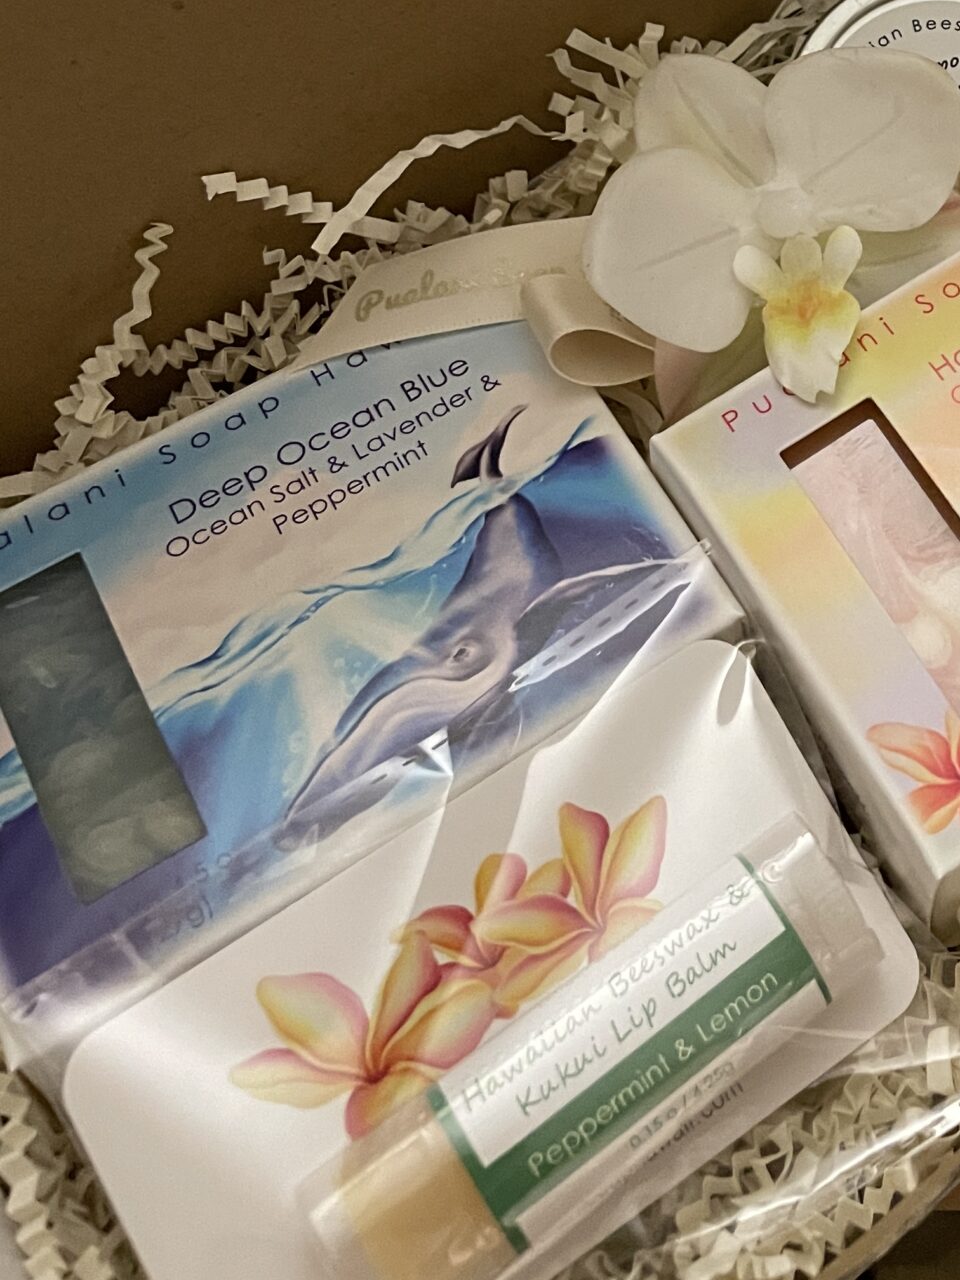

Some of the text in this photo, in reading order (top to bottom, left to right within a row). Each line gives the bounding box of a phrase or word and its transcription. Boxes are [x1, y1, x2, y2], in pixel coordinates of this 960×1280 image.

[0, 468, 126, 550] alani
[158, 392, 281, 466] Soap
[165, 373, 502, 559] Ocean Salt & Lavender &
[168, 357, 471, 525] Deep Ocean Blue
[272, 440, 430, 535] Peppermint
[459, 884, 750, 1112] Hawaiian Beeswax &
[514, 940, 738, 1117] Kukui Lip Balm
[528, 971, 779, 1177] Peppermint & Lemon
